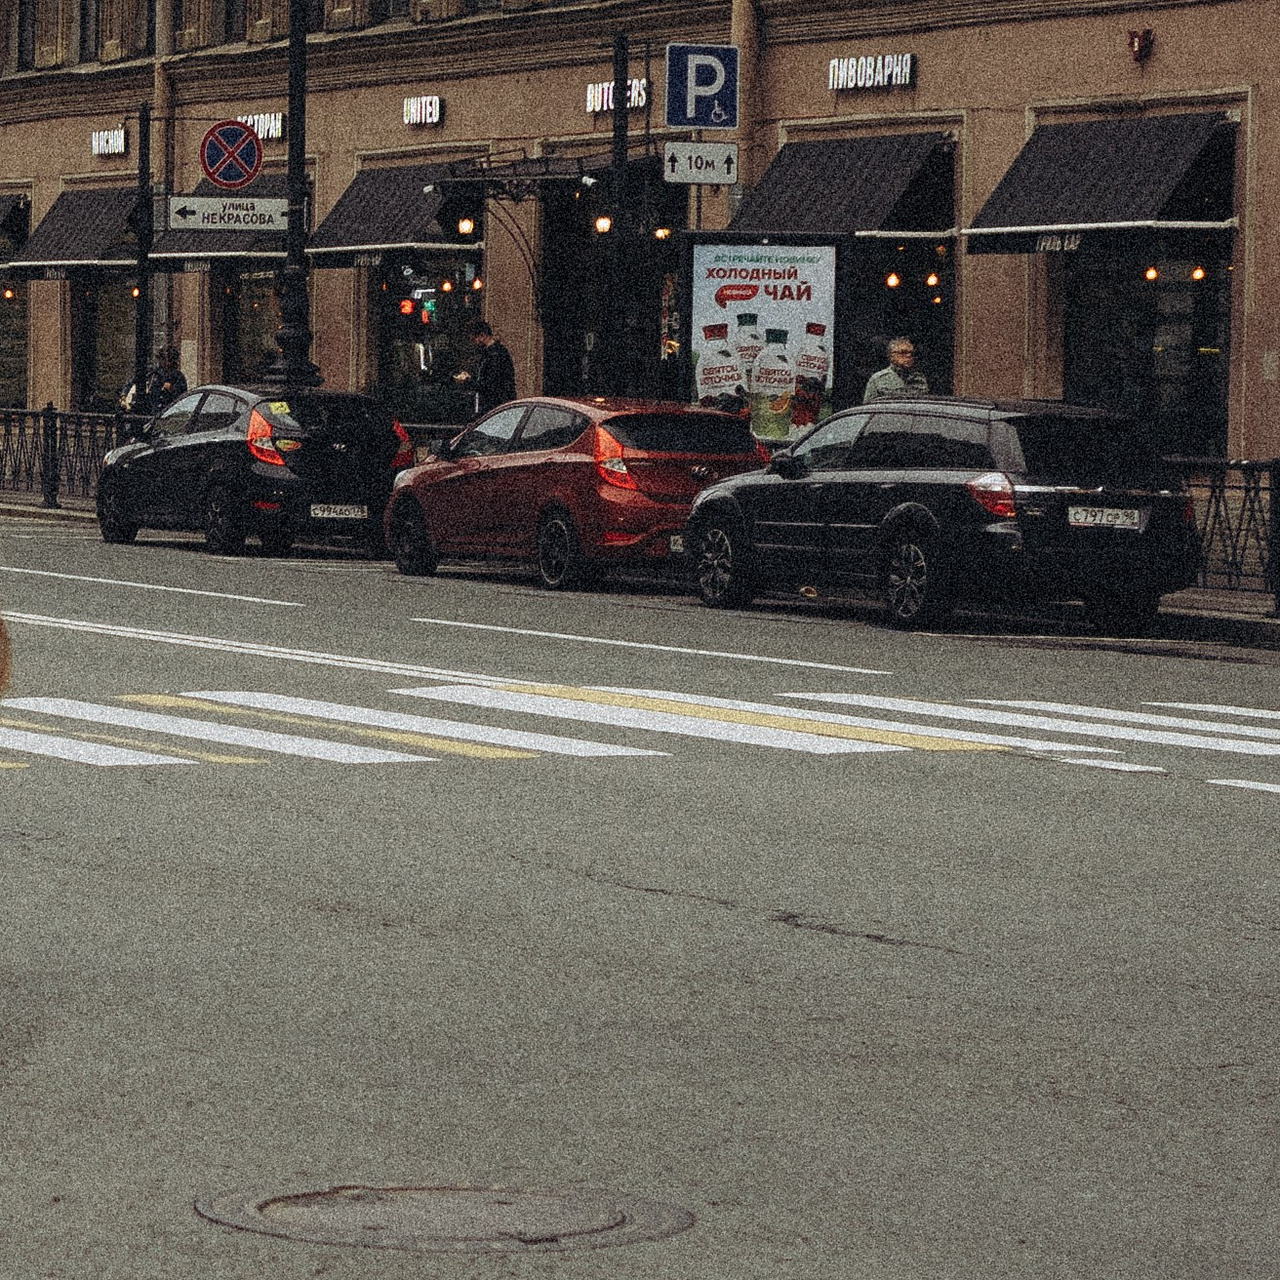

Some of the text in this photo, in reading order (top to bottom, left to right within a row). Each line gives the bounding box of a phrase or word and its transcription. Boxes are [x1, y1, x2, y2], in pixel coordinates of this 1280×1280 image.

[828, 54, 911, 89] ПИВОВАРНЯ
[586, 78, 647, 112] BUTCERS
[686, 54, 725, 119] P
[403, 95, 439, 124] UNITED
[202, 213, 275, 225] НЕКРАСОВА
[221, 202, 256, 213] улица
[706, 266, 799, 281] ХОЛОДНЫЙ
[764, 281, 812, 301] ЧАЙ
